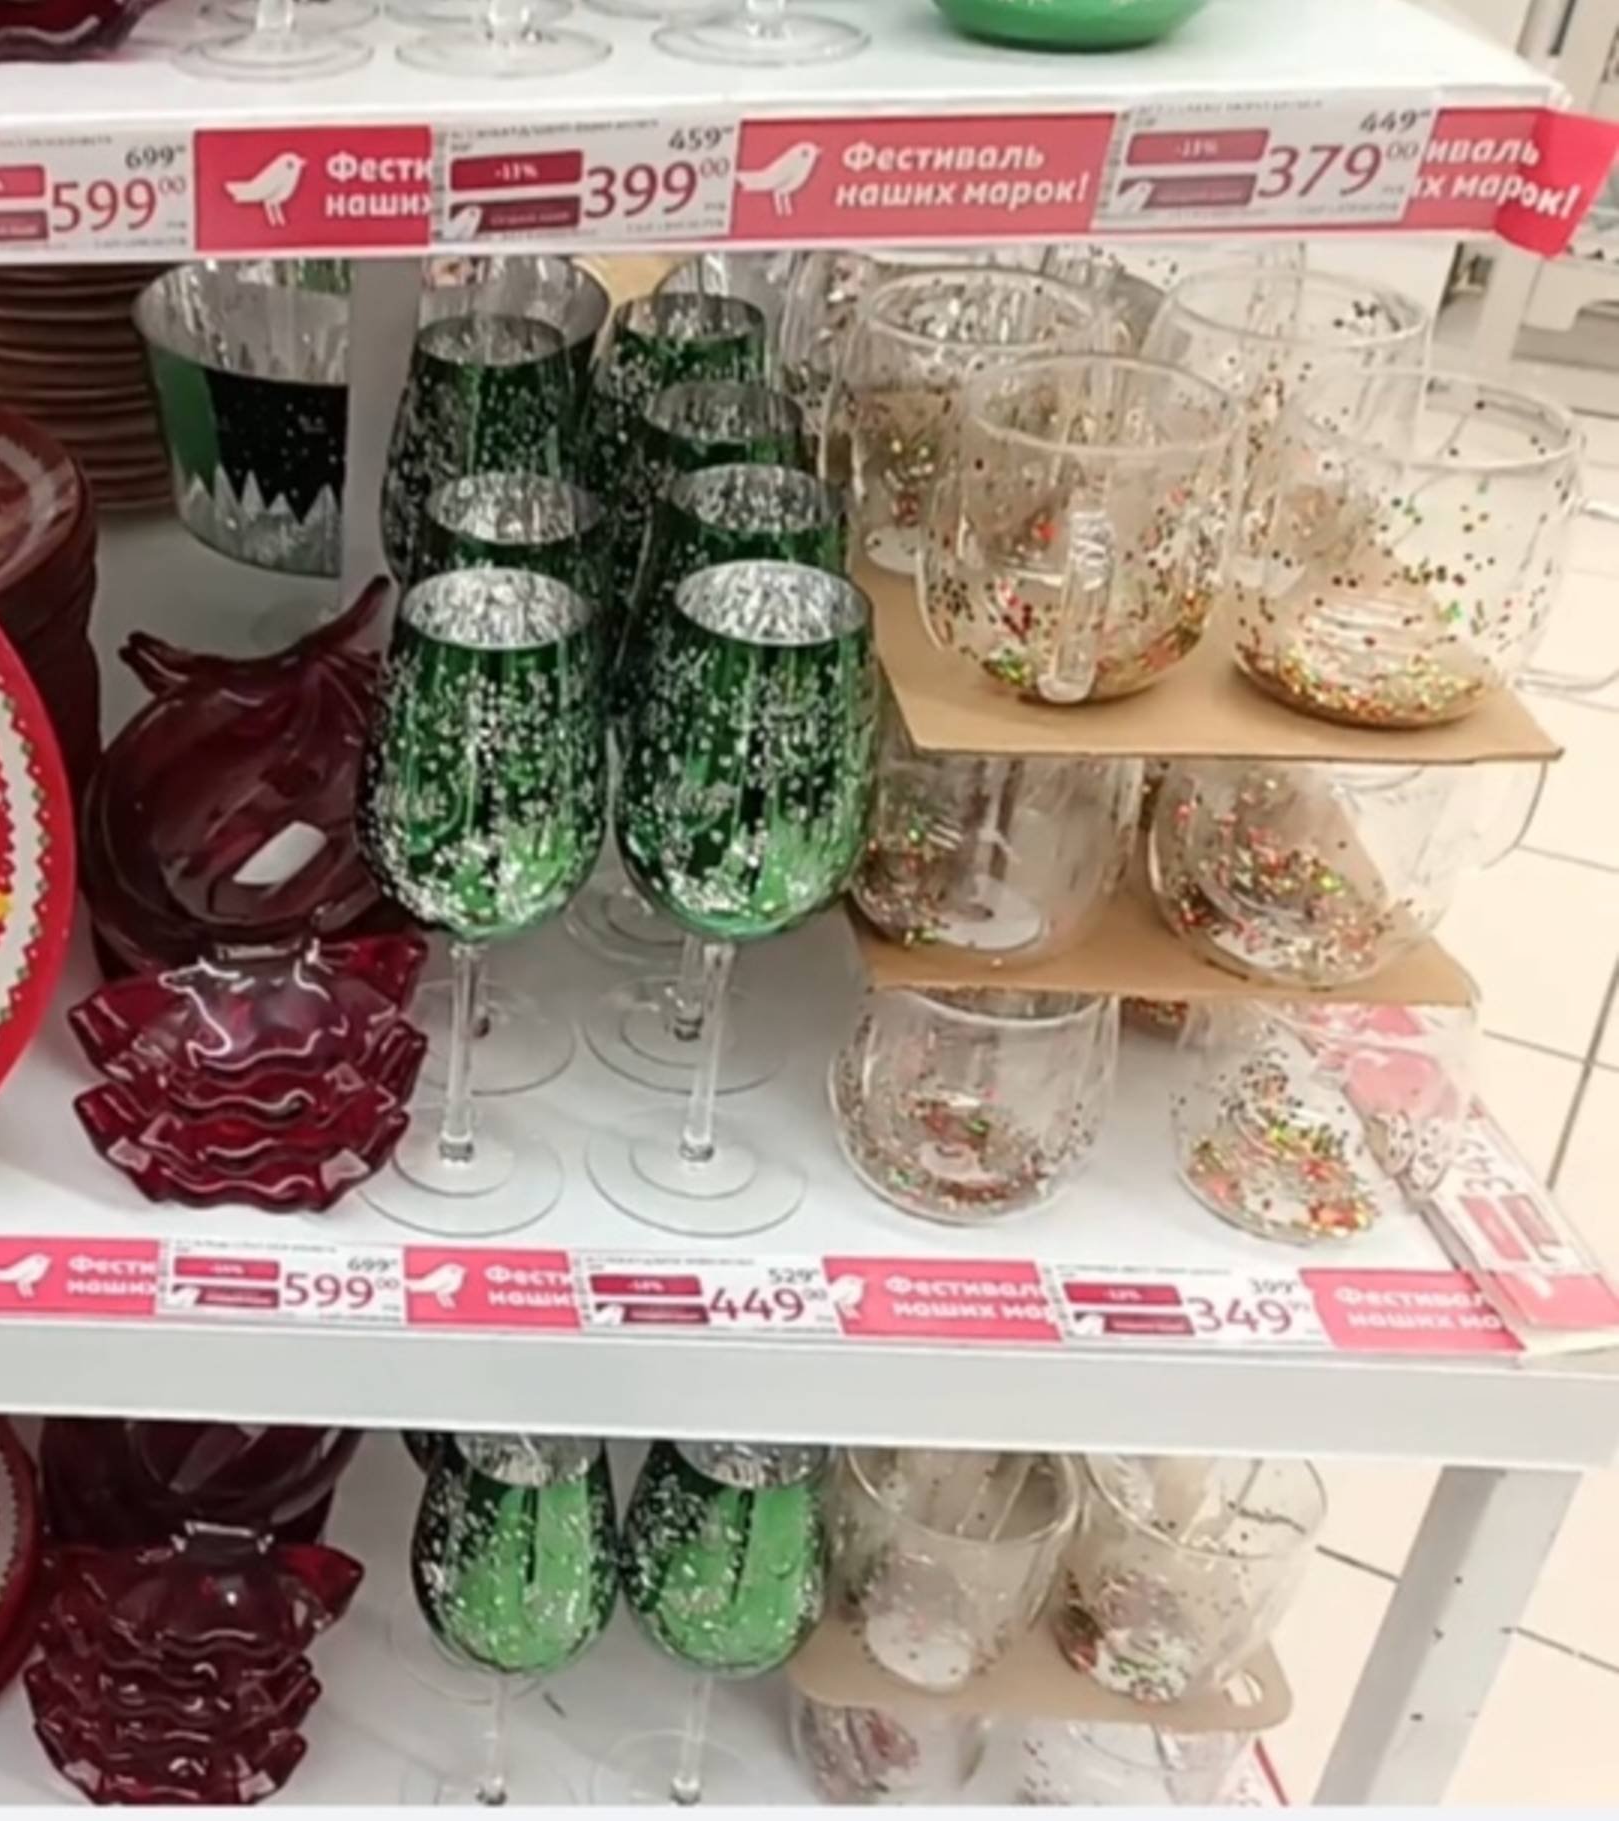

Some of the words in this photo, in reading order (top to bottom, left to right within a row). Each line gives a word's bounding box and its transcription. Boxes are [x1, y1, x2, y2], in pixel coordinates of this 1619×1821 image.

[1359, 109, 1418, 134] 449
[669, 126, 722, 151] 459
[124, 145, 175, 170] 699
[842, 141, 1045, 173] Фестиваль
[1256, 141, 1383, 198] 379
[1385, 139, 1418, 160] 00
[584, 160, 697, 219] 399
[700, 157, 730, 178] 00
[835, 178, 956, 208] наших
[962, 172, 1090, 212] марок!
[1453, 171, 1582, 220] марок!
[52, 178, 157, 232] 599
[347, 1256, 388, 1272] 699
[768, 1267, 809, 1285] 529
[284, 1271, 374, 1309] 599
[710, 1287, 805, 1322] 449
[892, 1301, 998, 1321] наших
[1183, 1296, 1293, 1335] 349
[1347, 1311, 1455, 1329] наших
